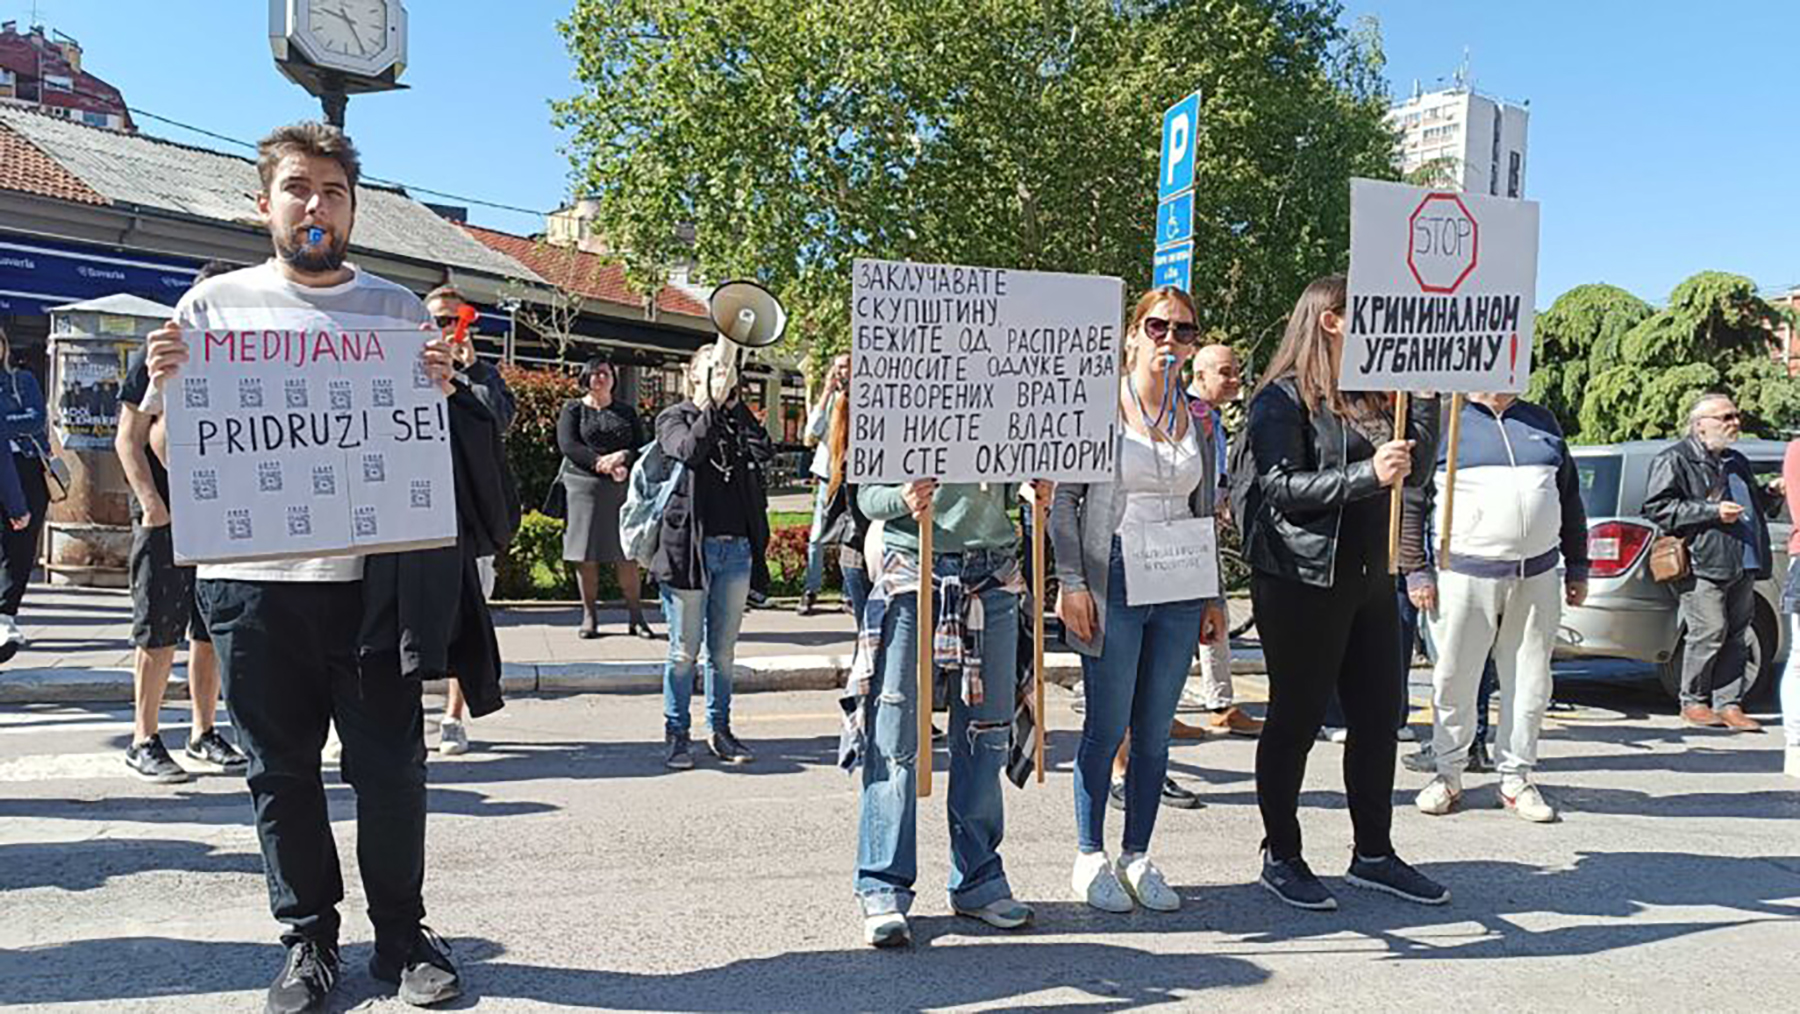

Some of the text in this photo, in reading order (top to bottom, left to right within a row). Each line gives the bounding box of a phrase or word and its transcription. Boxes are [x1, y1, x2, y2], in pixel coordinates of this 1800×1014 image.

[1167, 112, 1189, 185] P
[1415, 216, 1470, 256] STOP
[1350, 295, 1521, 335] КРИМИНАЛНОМ
[204, 331, 385, 367] MEDIJANA
[859, 325, 942, 353] БЕЖИТЕ
[959, 326, 991, 354] ОД
[854, 355, 1114, 381] ДОНОСИТЕ ОДЛУКЕ ИЗА
[857, 378, 1087, 409] ЗАТВОРЕНИХ ВРАТА
[392, 403, 446, 442] SE!
[856, 413, 885, 442] ВИ
[903, 413, 981, 443] НИСТЕ
[854, 423, 1114, 478] ВИ СТЕ ОКУПАТОРИ!
